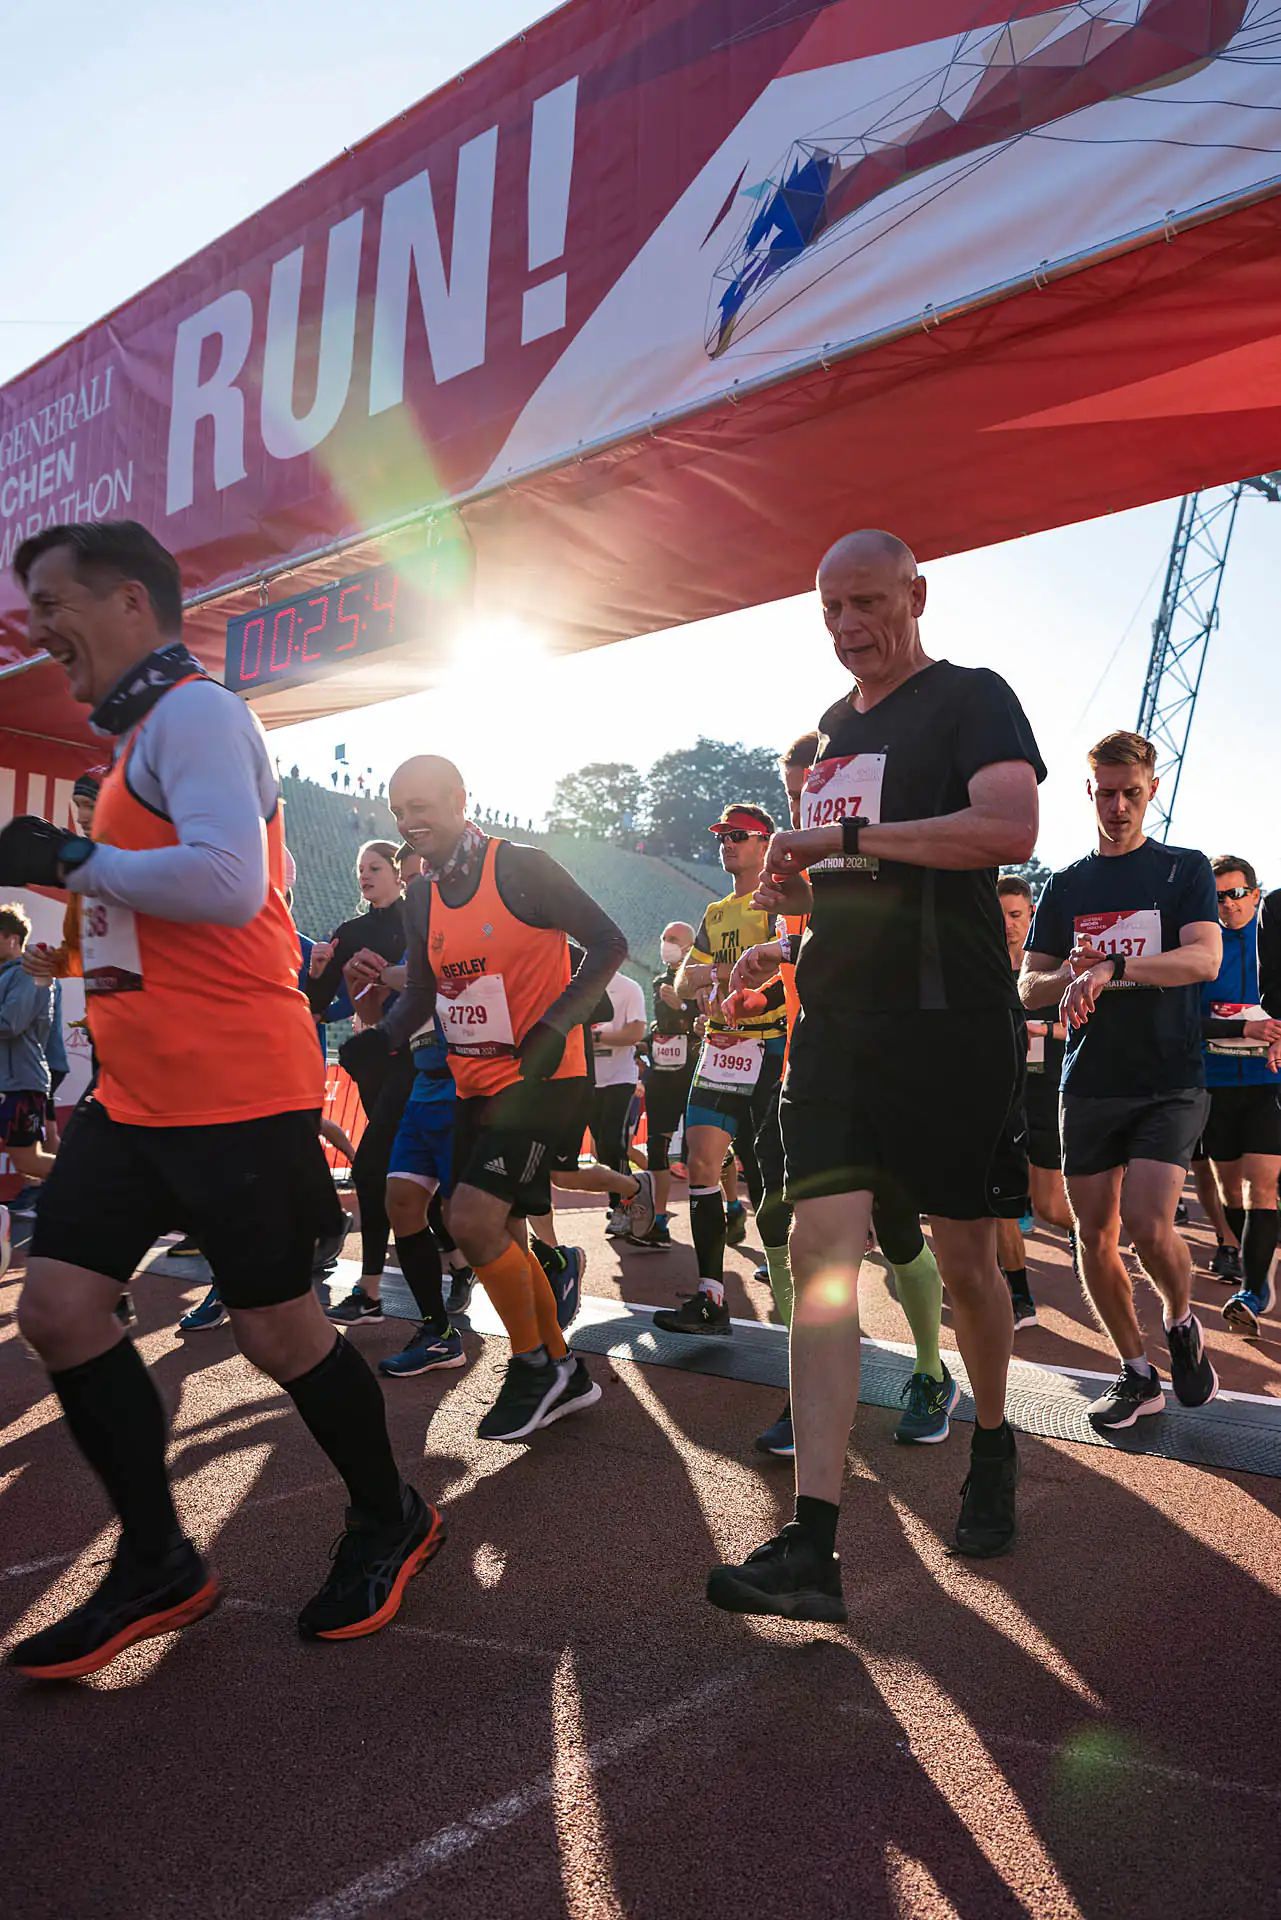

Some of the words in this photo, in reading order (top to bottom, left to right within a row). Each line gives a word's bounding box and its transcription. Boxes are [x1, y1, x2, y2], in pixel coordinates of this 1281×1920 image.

[166, 76, 578, 516] RUN!
[0, 366, 114, 471] GENERALI
[807, 796, 862, 828] 14287
[846, 857, 867, 868] 2021
[721, 929, 739, 949] TRI
[1090, 938, 1146, 957] 4137
[441, 957, 486, 979] BEXLEY
[448, 1005, 487, 1025] 2729
[657, 1047, 681, 1057] 14010
[712, 1052, 753, 1072] 13993
